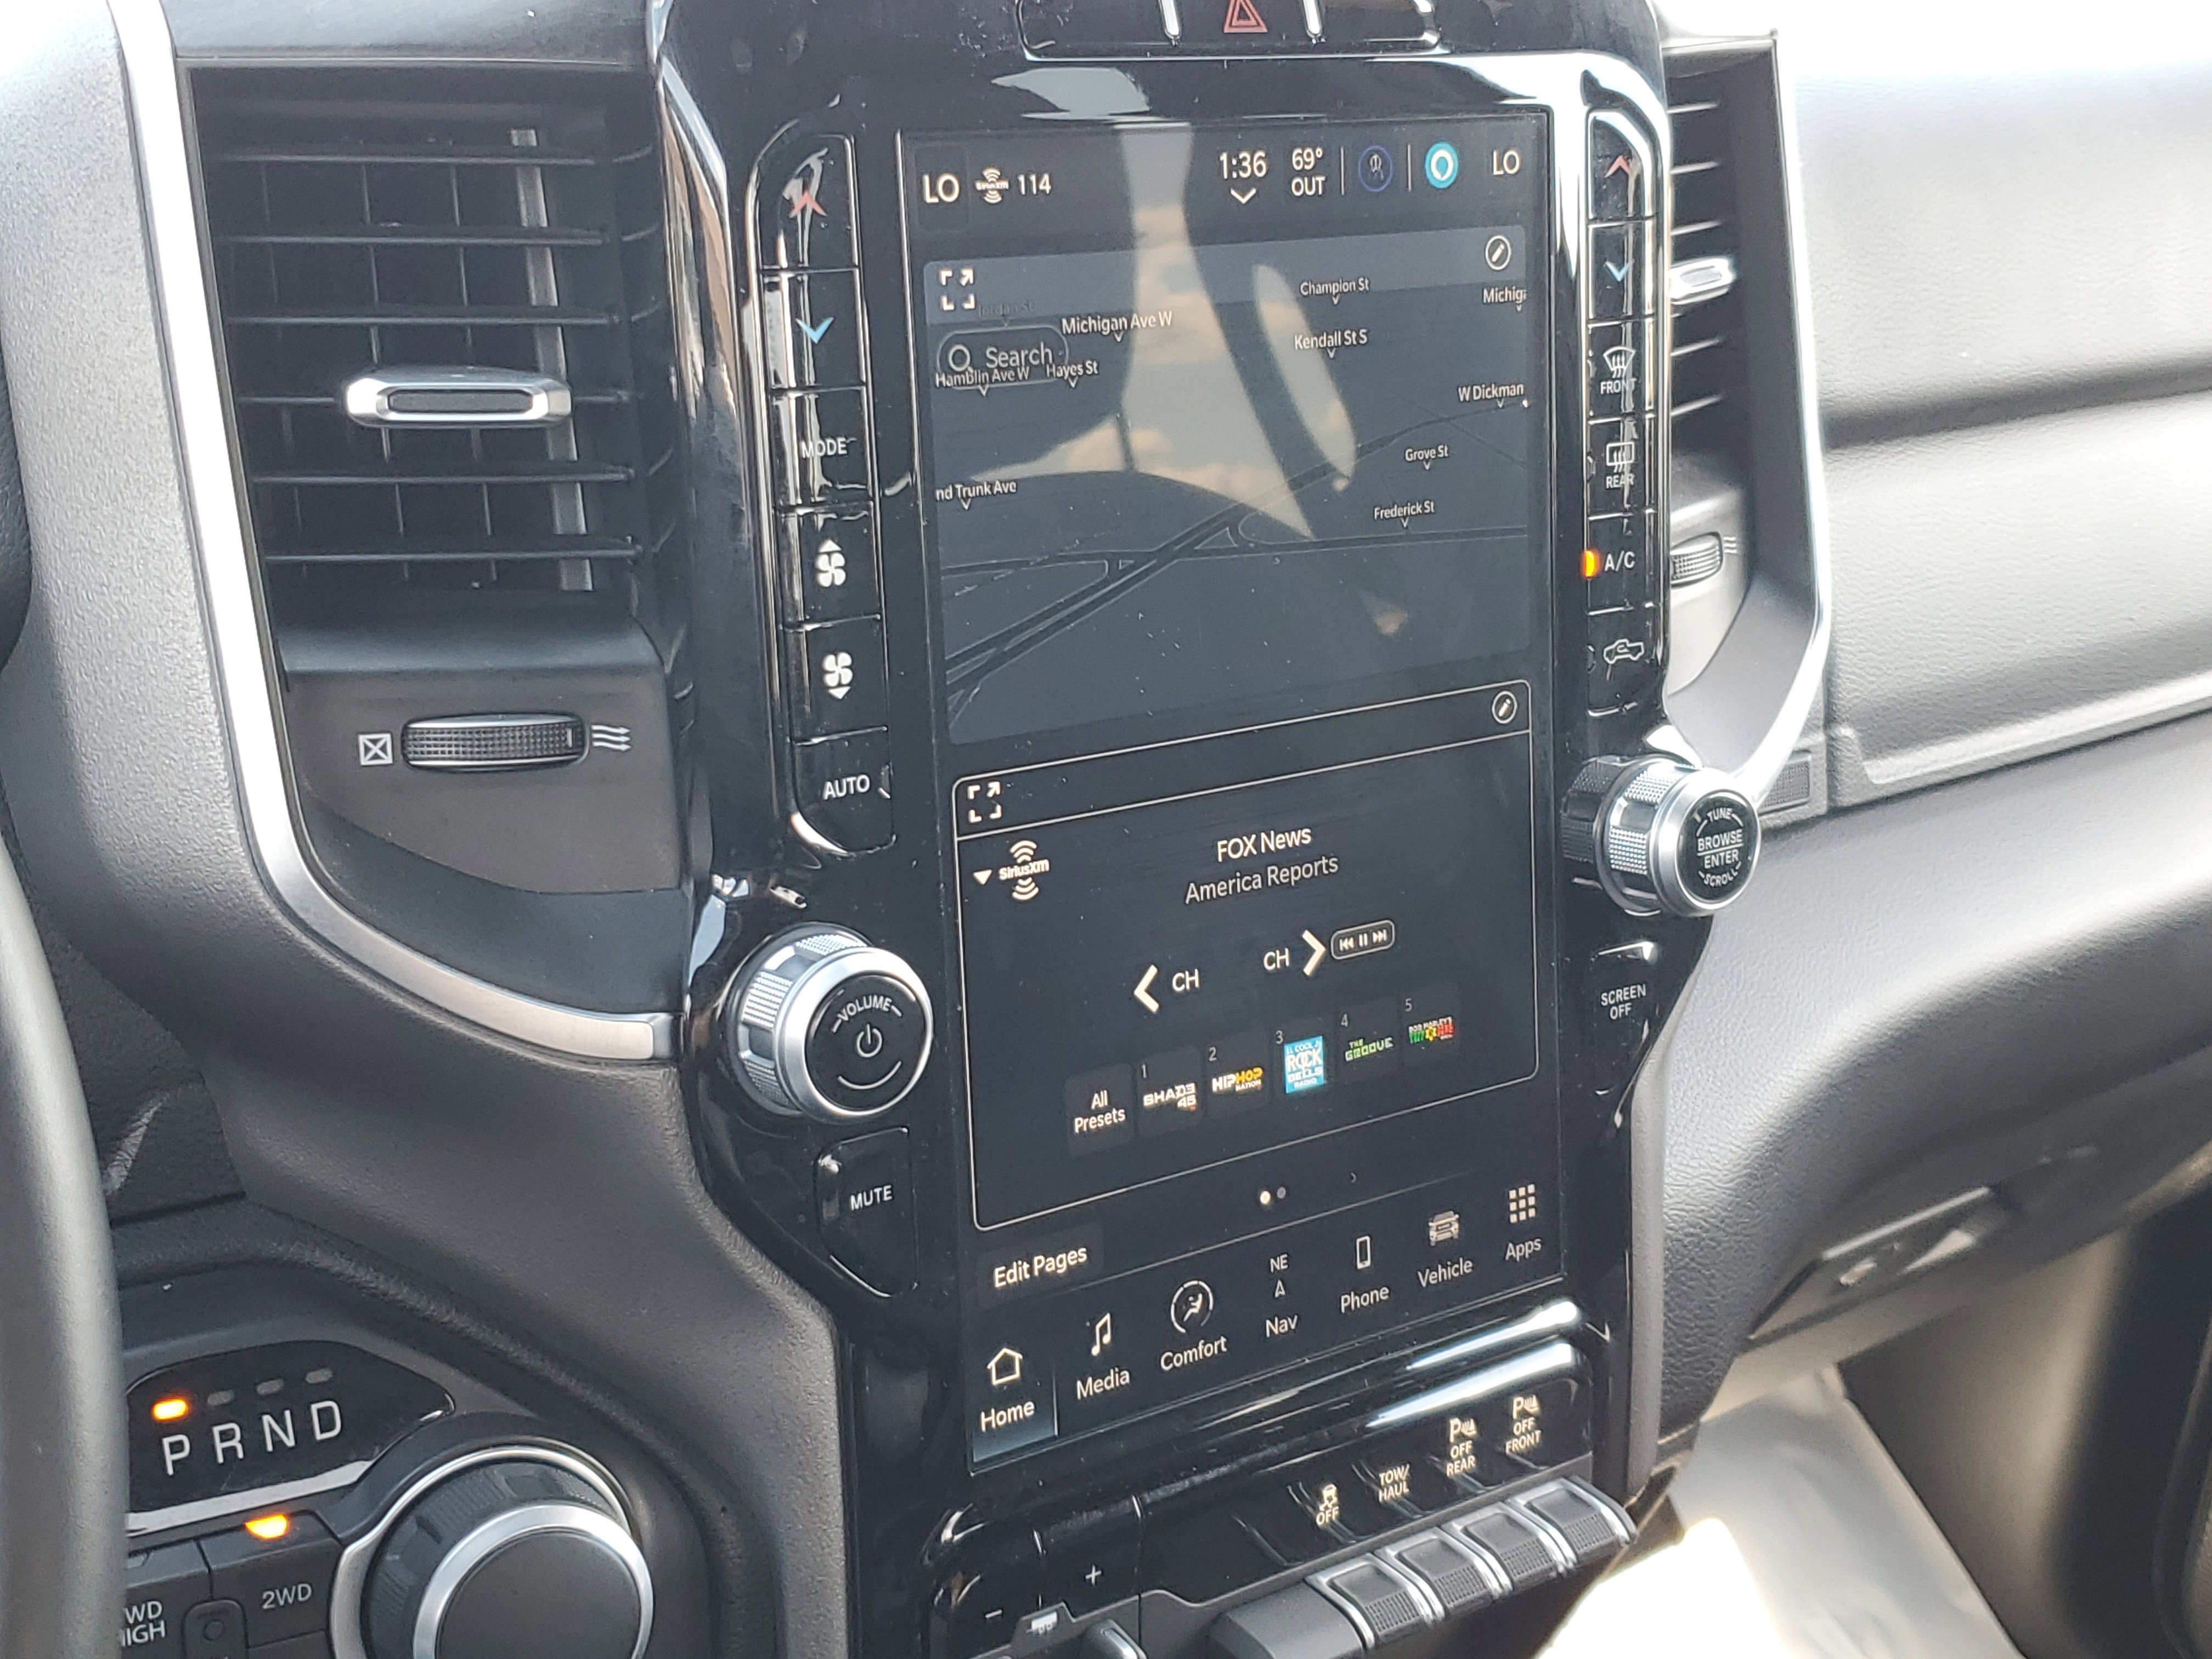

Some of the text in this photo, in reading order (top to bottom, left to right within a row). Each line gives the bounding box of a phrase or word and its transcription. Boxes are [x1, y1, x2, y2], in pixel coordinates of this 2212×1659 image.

[1220, 150, 1267, 179] 1:36
[1492, 149, 1520, 176] LO
[922, 174, 960, 204] LO
[1018, 172, 1051, 195] 114
[1291, 176, 1326, 198] OUT
[1300, 278, 1370, 298] Champion St
[1062, 311, 1173, 335] Michigan Ave W
[1294, 329, 1368, 350] Kendall St S
[985, 341, 1053, 370] Search
[935, 366, 1030, 387] Hamblin Ave W
[1046, 359, 1099, 380] Hayes St
[1458, 383, 1524, 402] W Dickman
[799, 437, 848, 459] MODE
[1404, 443, 1449, 461] Grove St
[953, 481, 992, 498] Trunk
[992, 479, 1017, 493] Ave
[1605, 473, 1635, 489] REAR
[1373, 499, 1435, 520] Frederick St
[1604, 550, 1636, 572] A/C
[823, 774, 871, 800] AUTO
[1706, 807, 1734, 822] TUNE
[1216, 827, 1313, 862] FOX News
[1697, 828, 1743, 851] BROWSE
[1703, 849, 1740, 870] ENTER
[1185, 855, 1339, 905] America Reports
[1703, 868, 1739, 887] SCROLL
[1263, 947, 1291, 972] CH
[1172, 968, 1200, 992] CH
[1404, 997, 1413, 1013] 5
[1600, 984, 1646, 1007] SCREEN
[834, 994, 892, 1023] VOLUME
[1609, 1002, 1633, 1020] OFF
[1341, 1013, 1349, 1028] 4
[1276, 1030, 1284, 1045] 3
[1345, 1036, 1394, 1062] GROOVE
[1208, 1047, 1217, 1062] 2
[1286, 1047, 1323, 1073] ROCK
[1141, 1063, 1147, 1079] 1
[1090, 1089, 1108, 1110] All
[1074, 1107, 1126, 1135] Presets
[850, 1184, 893, 1211] MUTE
[1504, 1237, 1542, 1262] Apps
[994, 1247, 1088, 1289] Edit Pages
[1269, 1254, 1289, 1273] NE
[1417, 1257, 1474, 1288] Vehicle
[1340, 1285, 1390, 1313] Phone
[1265, 1314, 1298, 1338] Nav
[1160, 1335, 1228, 1371] Comfort
[1076, 1367, 1130, 1400] Media
[980, 1400, 1035, 1432] Home
[1513, 1416, 1535, 1436] OFF
[162, 1400, 342, 1476] P R N D
[1450, 1440, 1473, 1459] OFF
[1505, 1429, 1542, 1454] FRONT
[1378, 1463, 1410, 1484] TOW/
[1446, 1455, 1476, 1478] REAR
[1379, 1480, 1410, 1503] HAUL
[1316, 1507, 1339, 1526] OFF
[262, 1582, 313, 1609] 2WD
[123, 1600, 163, 1624] WD
